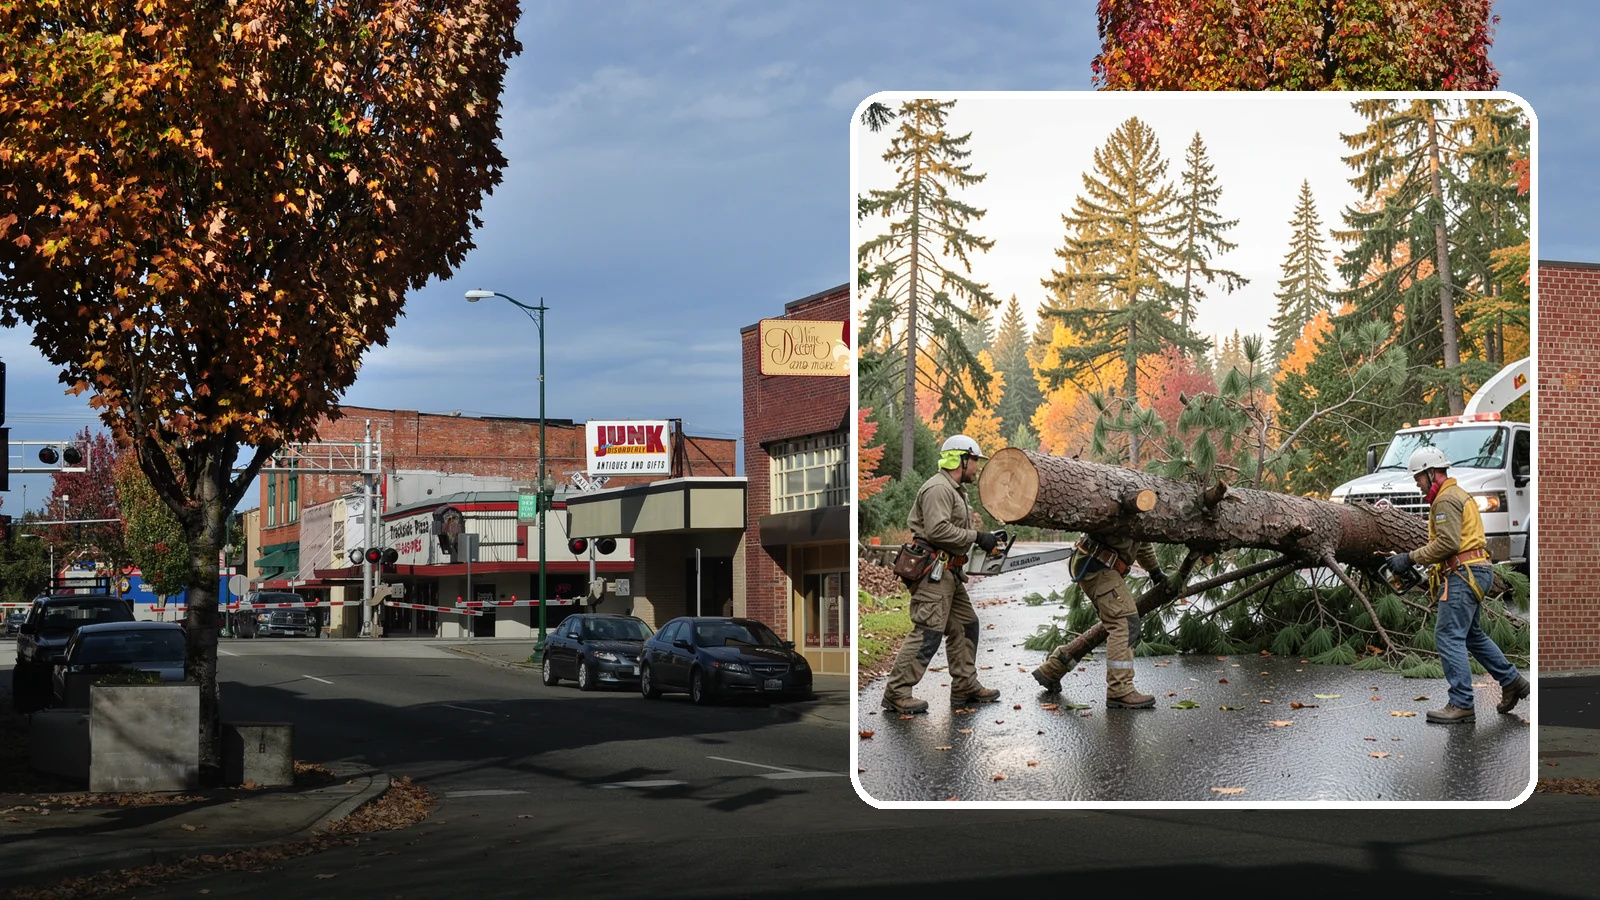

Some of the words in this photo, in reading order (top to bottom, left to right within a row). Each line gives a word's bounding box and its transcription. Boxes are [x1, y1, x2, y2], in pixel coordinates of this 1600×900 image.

[595, 425, 665, 457] JUNK
[607, 446, 646, 454] DISORDERLY
[596, 461, 628, 470] ANTIQUES
[631, 461, 644, 470] AND
[647, 460, 665, 470] GIFTS
[414, 520, 429, 535] Pizza
